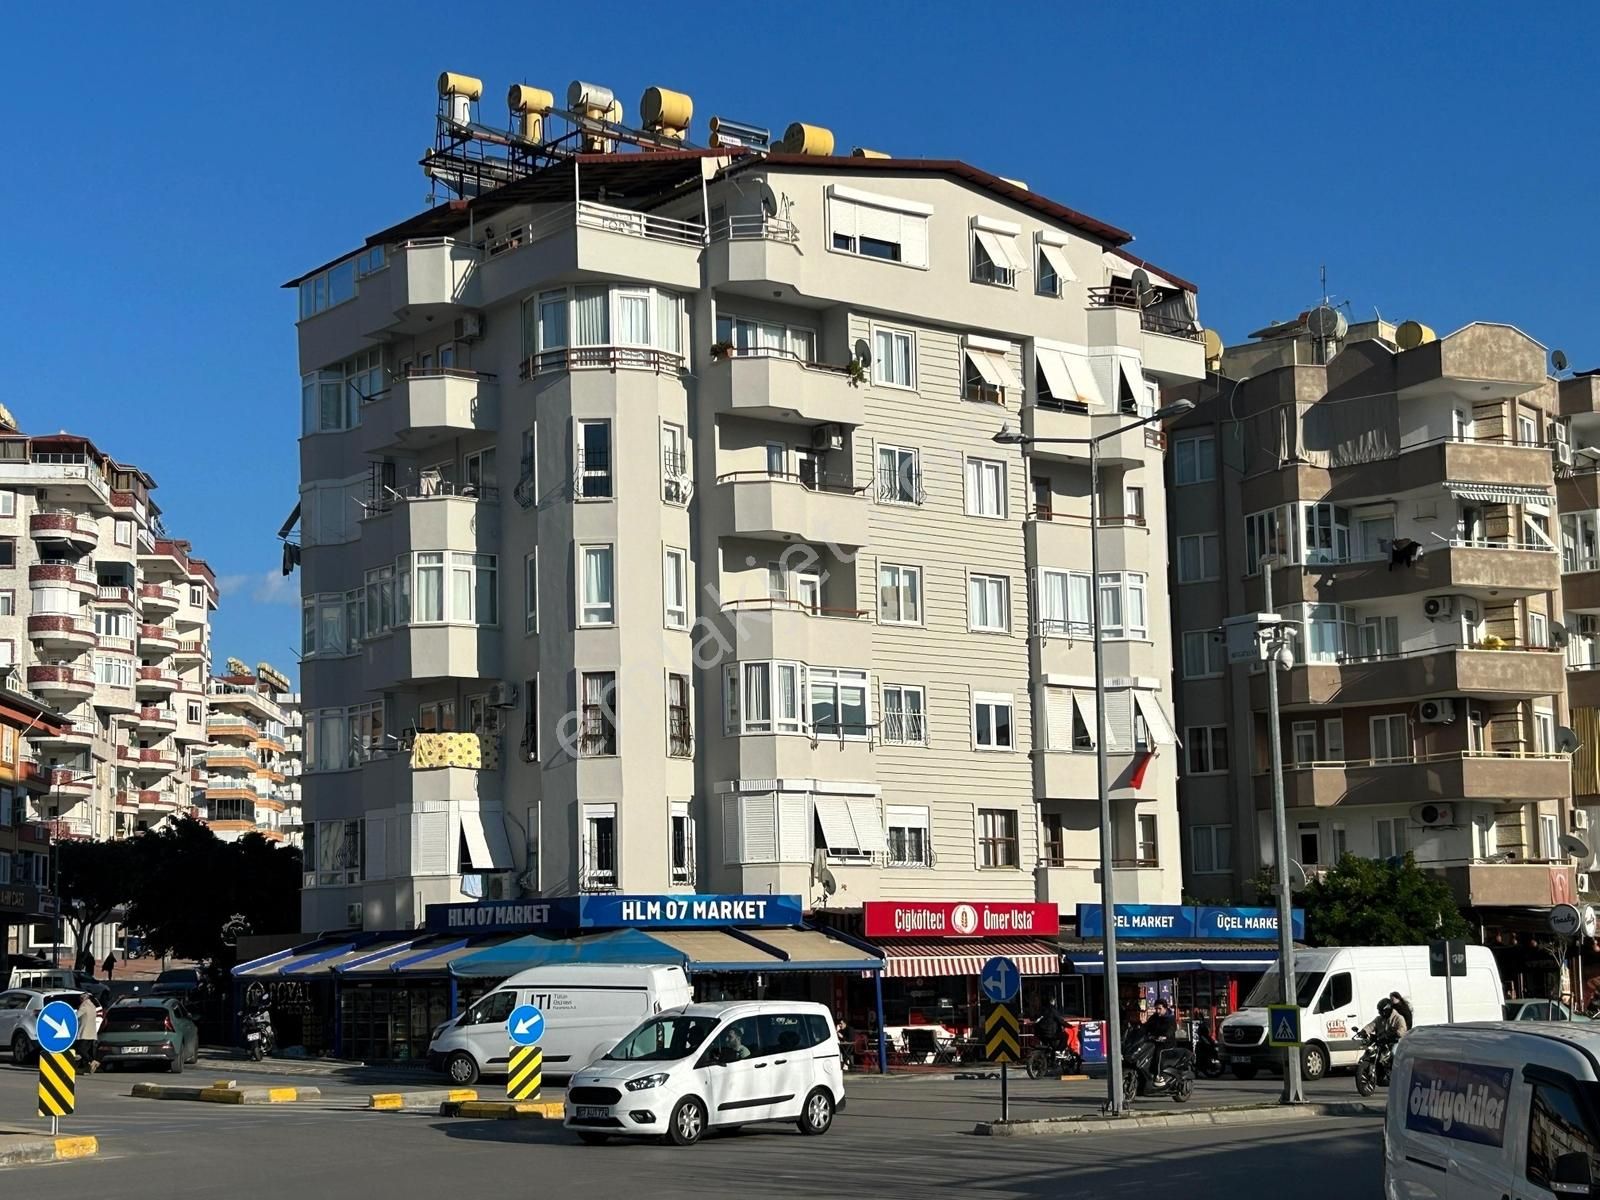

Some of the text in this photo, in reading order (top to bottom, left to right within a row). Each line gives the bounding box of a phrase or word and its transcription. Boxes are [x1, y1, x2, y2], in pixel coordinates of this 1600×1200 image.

[448, 905, 550, 926] HLM 07 MARKET
[622, 901, 767, 920] HLM 07 MARKET
[895, 906, 1032, 932] Çiğköfteci Ömer Usta
[1132, 915, 1174, 928] MARKET
[1217, 914, 1278, 931] ÜÇEL MARKE
[1410, 1079, 1505, 1132] öztiryakiler
